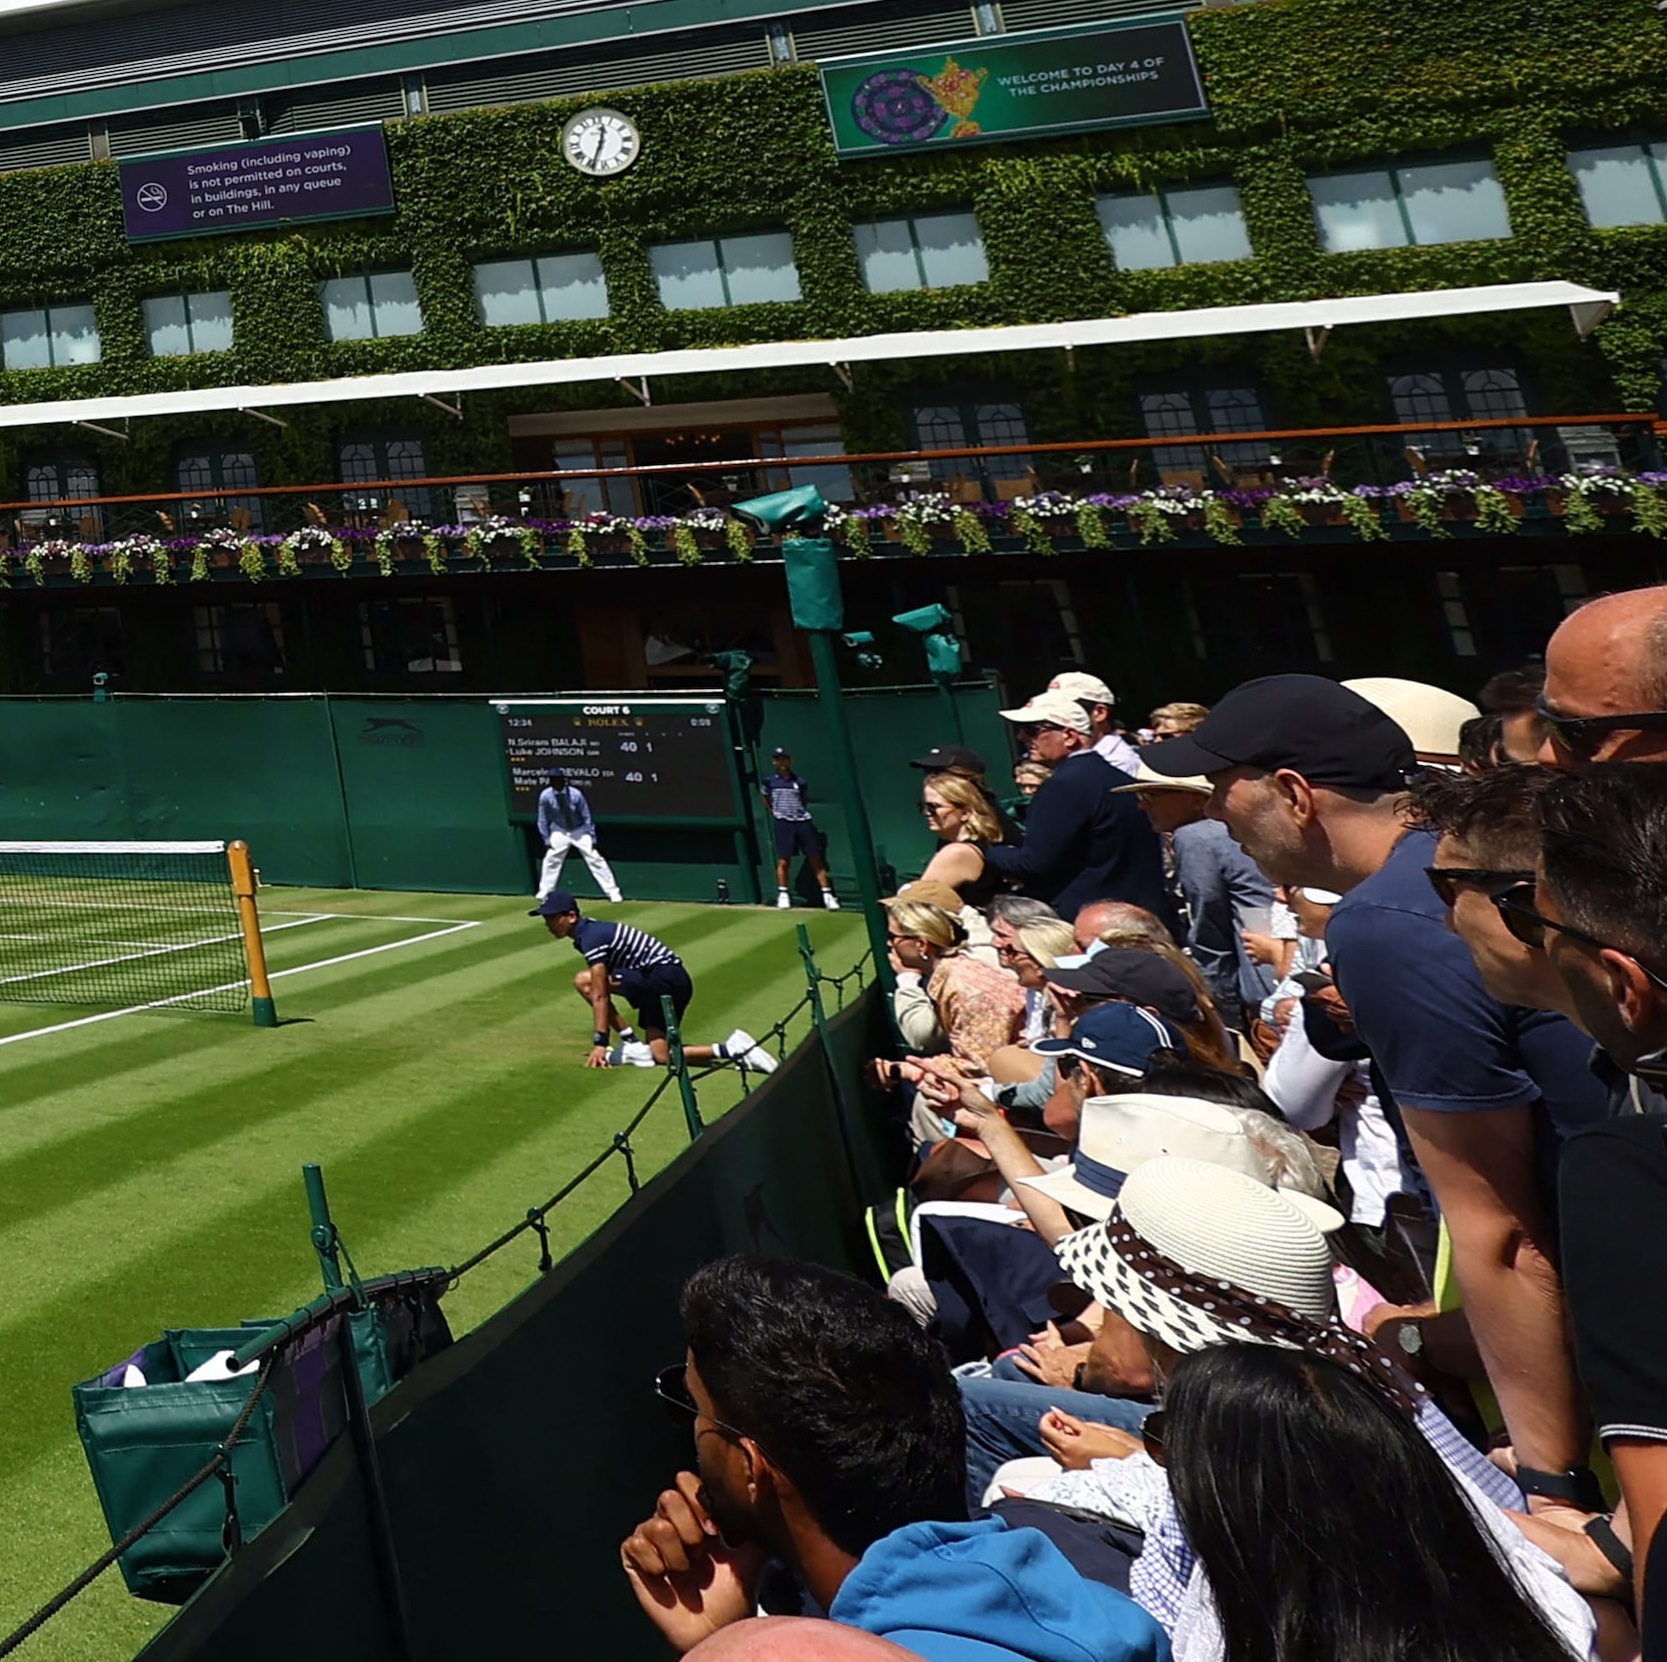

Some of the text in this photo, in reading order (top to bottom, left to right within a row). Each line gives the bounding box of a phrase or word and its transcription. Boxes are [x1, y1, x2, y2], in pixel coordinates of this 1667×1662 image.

[997, 57, 1164, 86] WELCOME TO DAY 4 OF
[1008, 71, 1159, 97] THE CHAMPIONSHIPS
[187, 145, 351, 176] Smoking (including vaping)
[189, 160, 347, 190] is not permitted on courts,
[191, 178, 341, 204] in buildings, in any queue
[193, 200, 274, 219] or on The Hill.
[583, 706, 630, 715] COURT 6
[588, 718, 629, 727] ROLEX
[509, 748, 533, 756] Luke
[535, 748, 584, 756] JOHNSON
[620, 741, 653, 752] 40 1
[625, 772, 658, 783] 40 1
